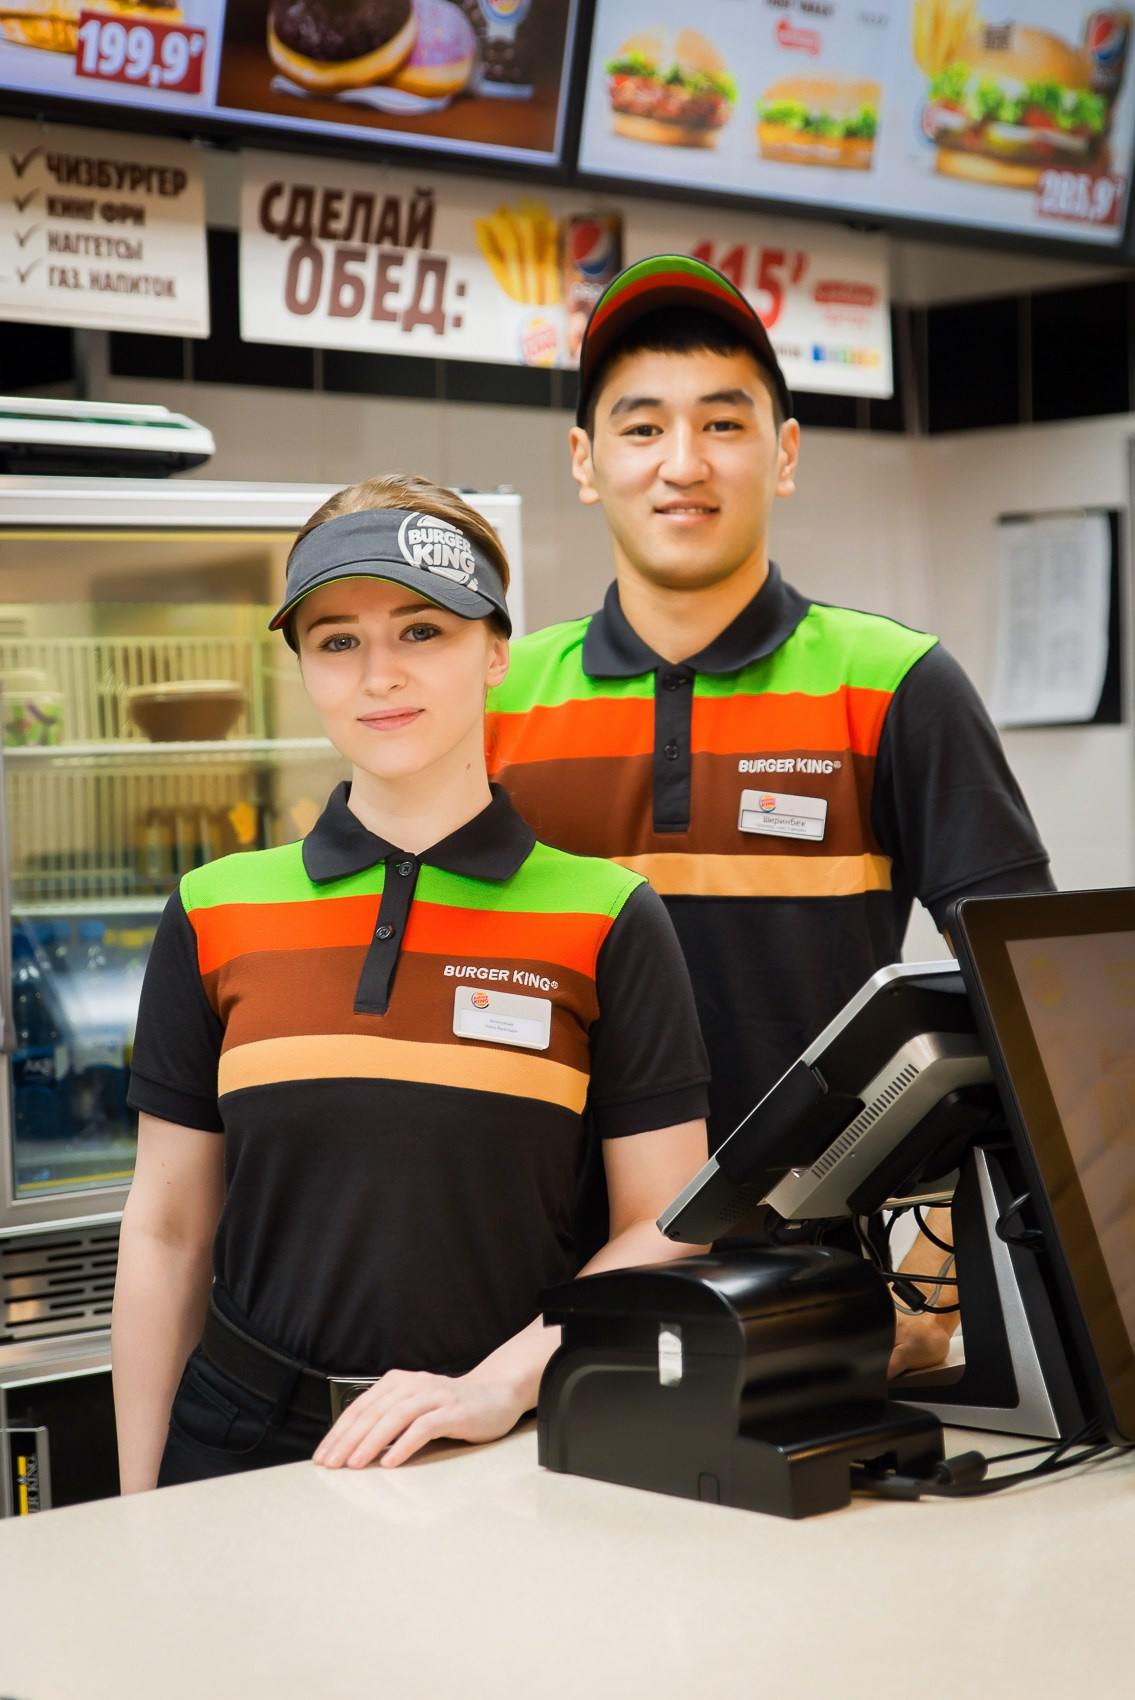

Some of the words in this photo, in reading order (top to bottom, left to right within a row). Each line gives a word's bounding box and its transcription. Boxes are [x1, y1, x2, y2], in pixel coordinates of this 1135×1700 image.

[46, 152, 189, 196] ЧИЗБУРГЕР
[47, 194, 97, 221] КИНГ
[99, 200, 146, 226] ФРИ
[259, 181, 436, 250] СДЕЛАЙ
[48, 229, 143, 260] НАГГЕТСЫ
[48, 264, 84, 289] ГАЗ.
[88, 268, 176, 298] НАПИТОК
[284, 243, 466, 335] ОБЕД:
[408, 528, 472, 554] BURGER
[412, 543, 476, 575] KING
[738, 758, 795, 773] BURGER
[443, 965, 510, 981] BURGER
